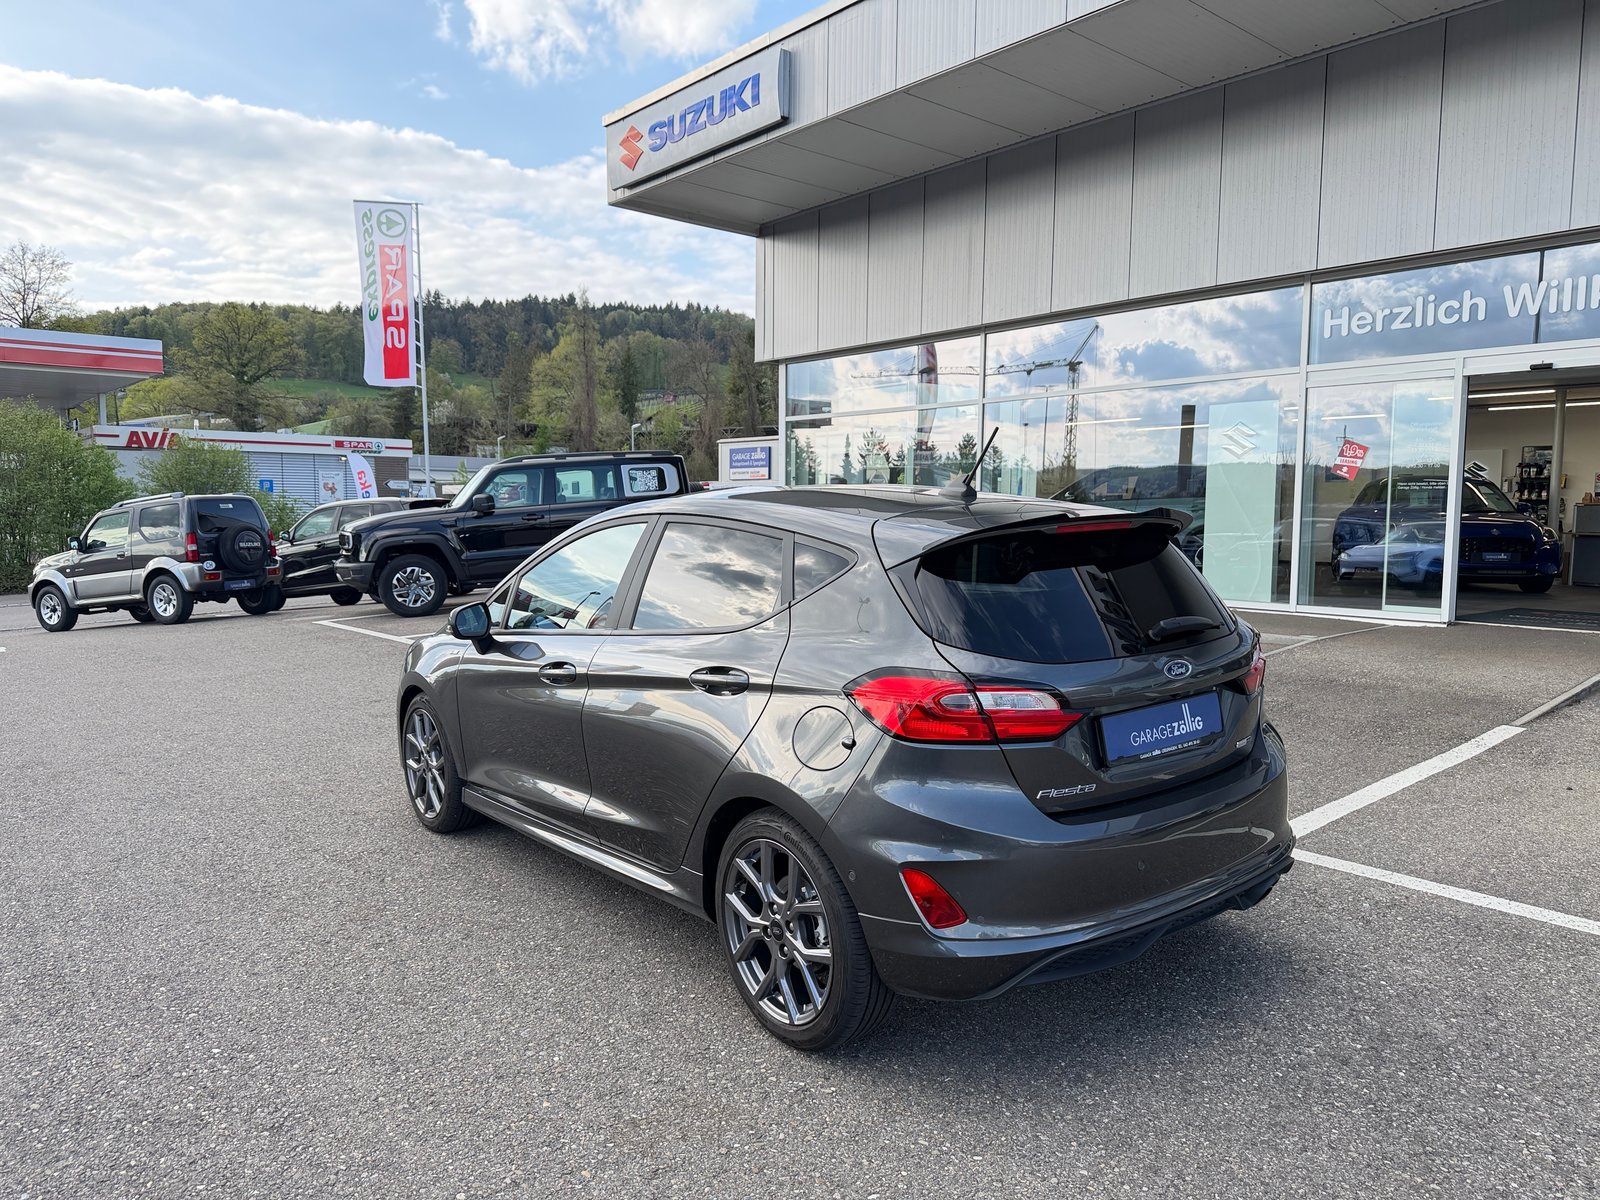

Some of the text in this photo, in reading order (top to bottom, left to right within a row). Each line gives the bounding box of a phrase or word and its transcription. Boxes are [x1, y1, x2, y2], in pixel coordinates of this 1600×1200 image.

[648, 73, 760, 152] SUZUKI
[1323, 289, 1487, 339] Herzlich
[343, 441, 373, 450] SPAR
[205, 562, 214, 570] CH
[1168, 662, 1188, 677] Ford
[1036, 783, 1097, 800] Fiesta
